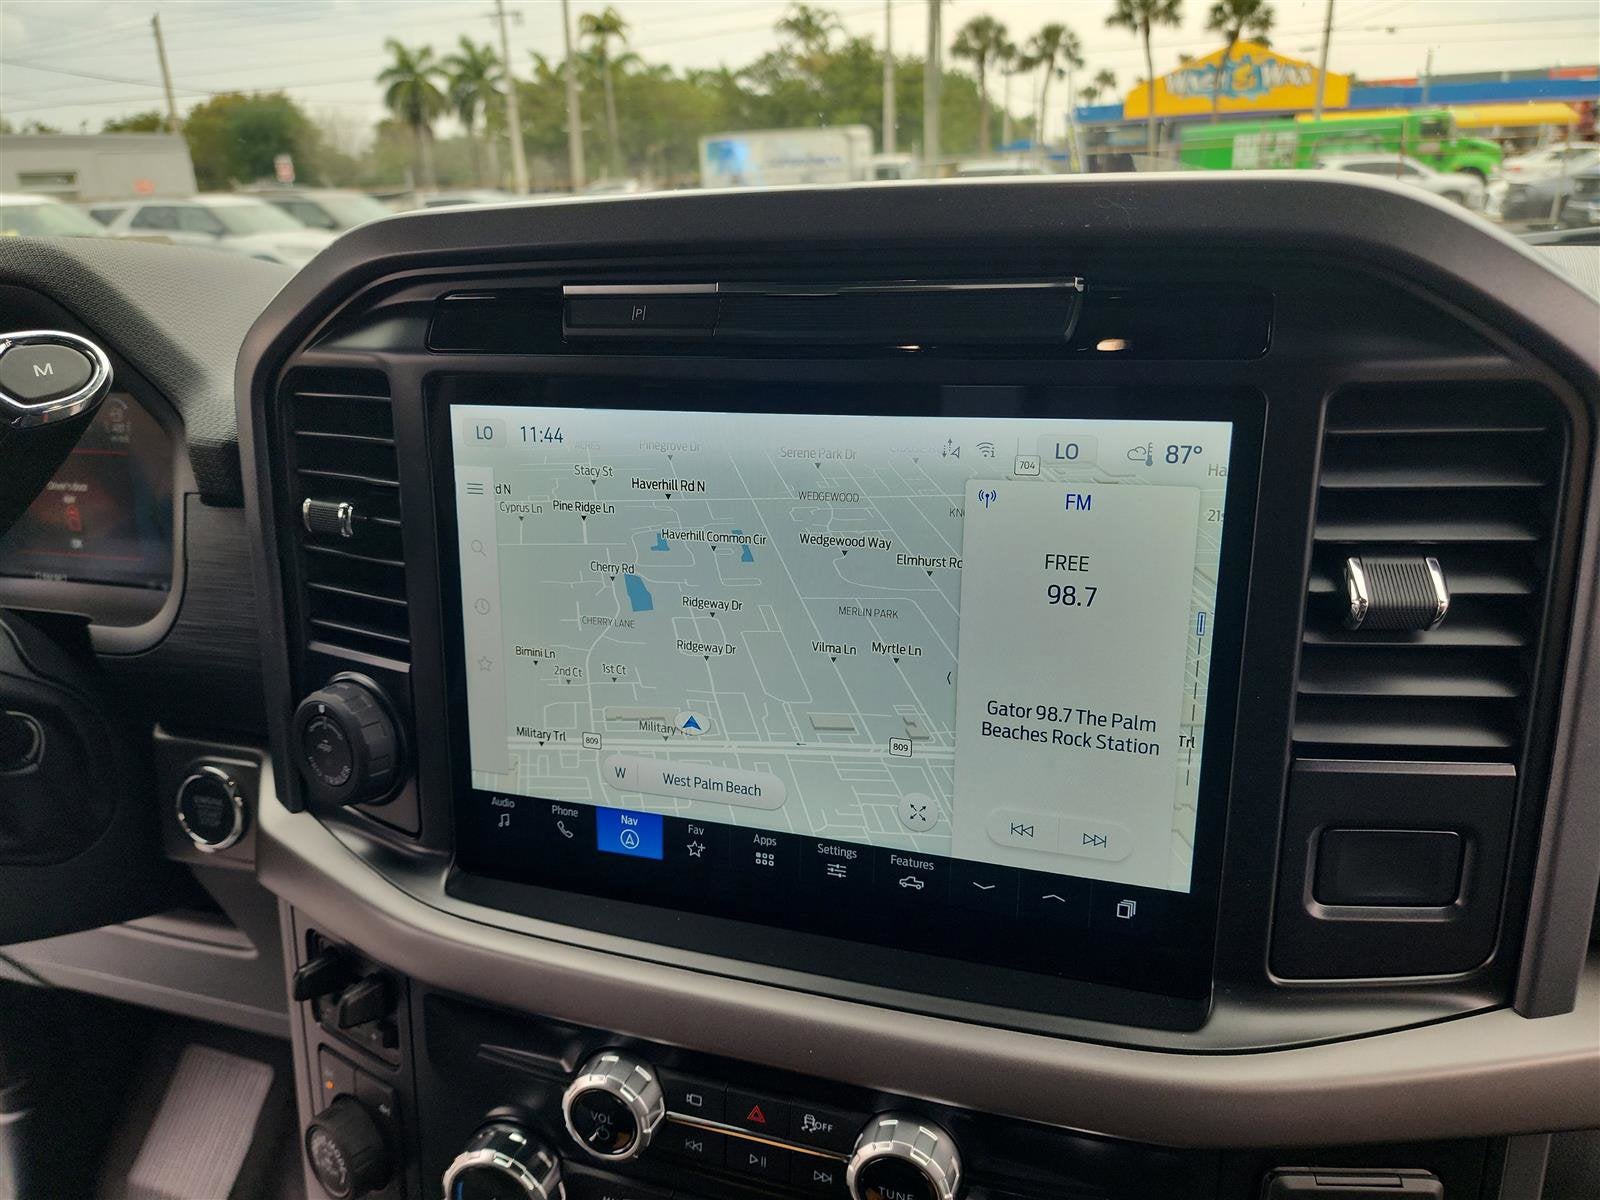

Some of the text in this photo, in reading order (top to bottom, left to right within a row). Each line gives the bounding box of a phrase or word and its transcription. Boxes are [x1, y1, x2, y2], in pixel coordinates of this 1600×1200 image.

[32, 362, 54, 377] M
[476, 425, 564, 444] LO 11:44
[639, 440, 688, 453] Pinegrove
[780, 447, 856, 460] Serene Park Dr
[1055, 443, 1079, 460] LO
[1165, 444, 1202, 465] 87°
[574, 465, 614, 478] Stacy St
[1019, 460, 1035, 470] 704
[503, 483, 512, 495] N
[631, 478, 706, 492] Haverhill Rd N
[798, 491, 860, 503] WEDGEWOOD
[1065, 494, 1092, 511] FM
[499, 502, 543, 515] Cyprus Ln
[552, 500, 615, 515] Pine Ridge Ln
[662, 528, 767, 545] Haverhill Common Cir
[800, 532, 892, 551] Wedgewood Way
[896, 553, 946, 568] Elmhurst
[1044, 554, 1090, 572] FREE
[590, 561, 635, 575] Cherry Rd
[1047, 584, 1098, 608] 98.7
[682, 596, 743, 612] Ridgeway Dr
[838, 606, 899, 620] MERLIN PARK
[581, 615, 635, 629] CHERRY LANE
[515, 645, 556, 659] Bimini Ln
[676, 640, 736, 655] Ridgeway Dr
[812, 641, 857, 655] Vilma Ln
[872, 642, 922, 656] Myrtle Ln
[554, 665, 583, 678] 2nd Ct
[602, 664, 626, 675] 1st Ct
[987, 700, 1156, 732] Gator 98.7 The Palm
[516, 726, 566, 742] Military Trl
[639, 721, 676, 736] Military
[585, 736, 599, 745] 809
[981, 721, 1160, 756] Beaches Rock Station
[1178, 735, 1195, 748] Trl
[893, 742, 908, 752] 809
[614, 767, 626, 779] W
[662, 772, 762, 797] West Palm Beach
[491, 796, 515, 809] Audio
[551, 804, 578, 818] Phone
[621, 814, 638, 826] Nav
[688, 824, 704, 836] Fav
[753, 833, 777, 847] Apps
[817, 843, 857, 859] Settings
[890, 854, 935, 871] Features
[590, 1110, 614, 1126] VOL
[816, 1122, 833, 1134] OFF
[878, 1186, 914, 1200] TUNE
